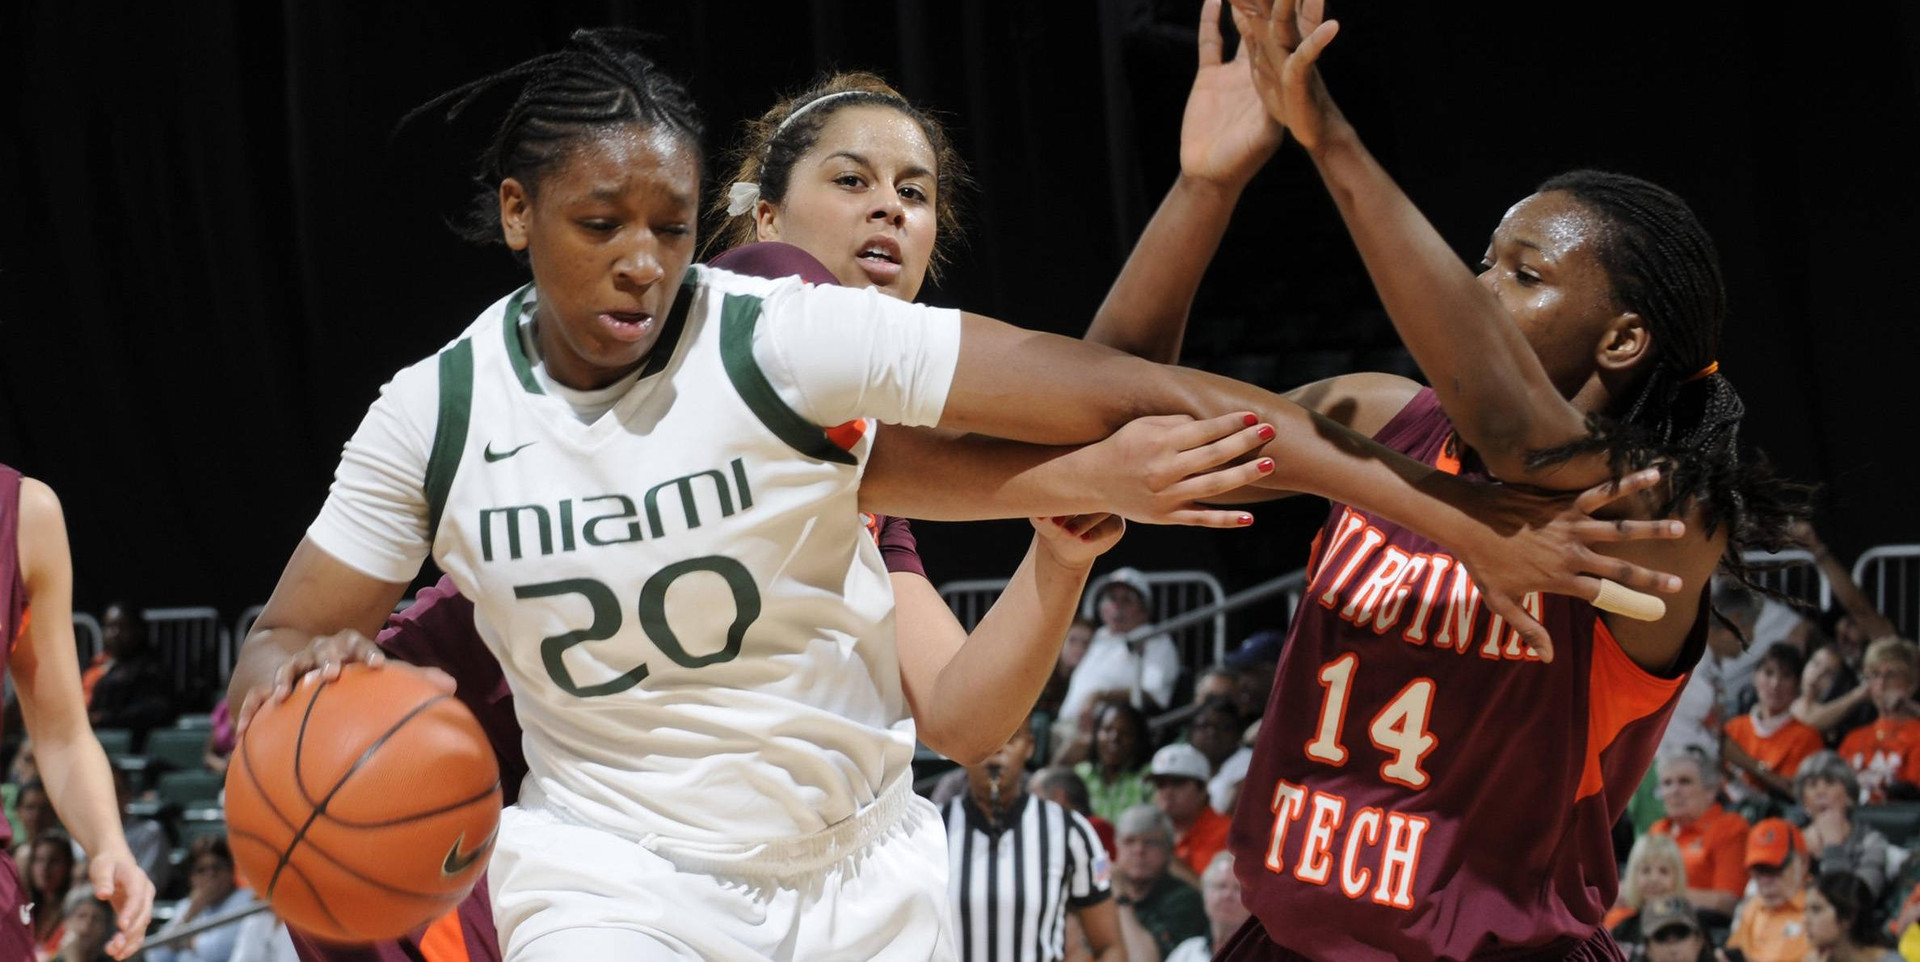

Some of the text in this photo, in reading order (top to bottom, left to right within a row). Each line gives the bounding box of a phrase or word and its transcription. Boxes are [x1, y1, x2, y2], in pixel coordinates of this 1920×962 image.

[512, 554, 762, 698] 20
[1304, 652, 1439, 790] 14
[1264, 778, 1430, 911] TECH
